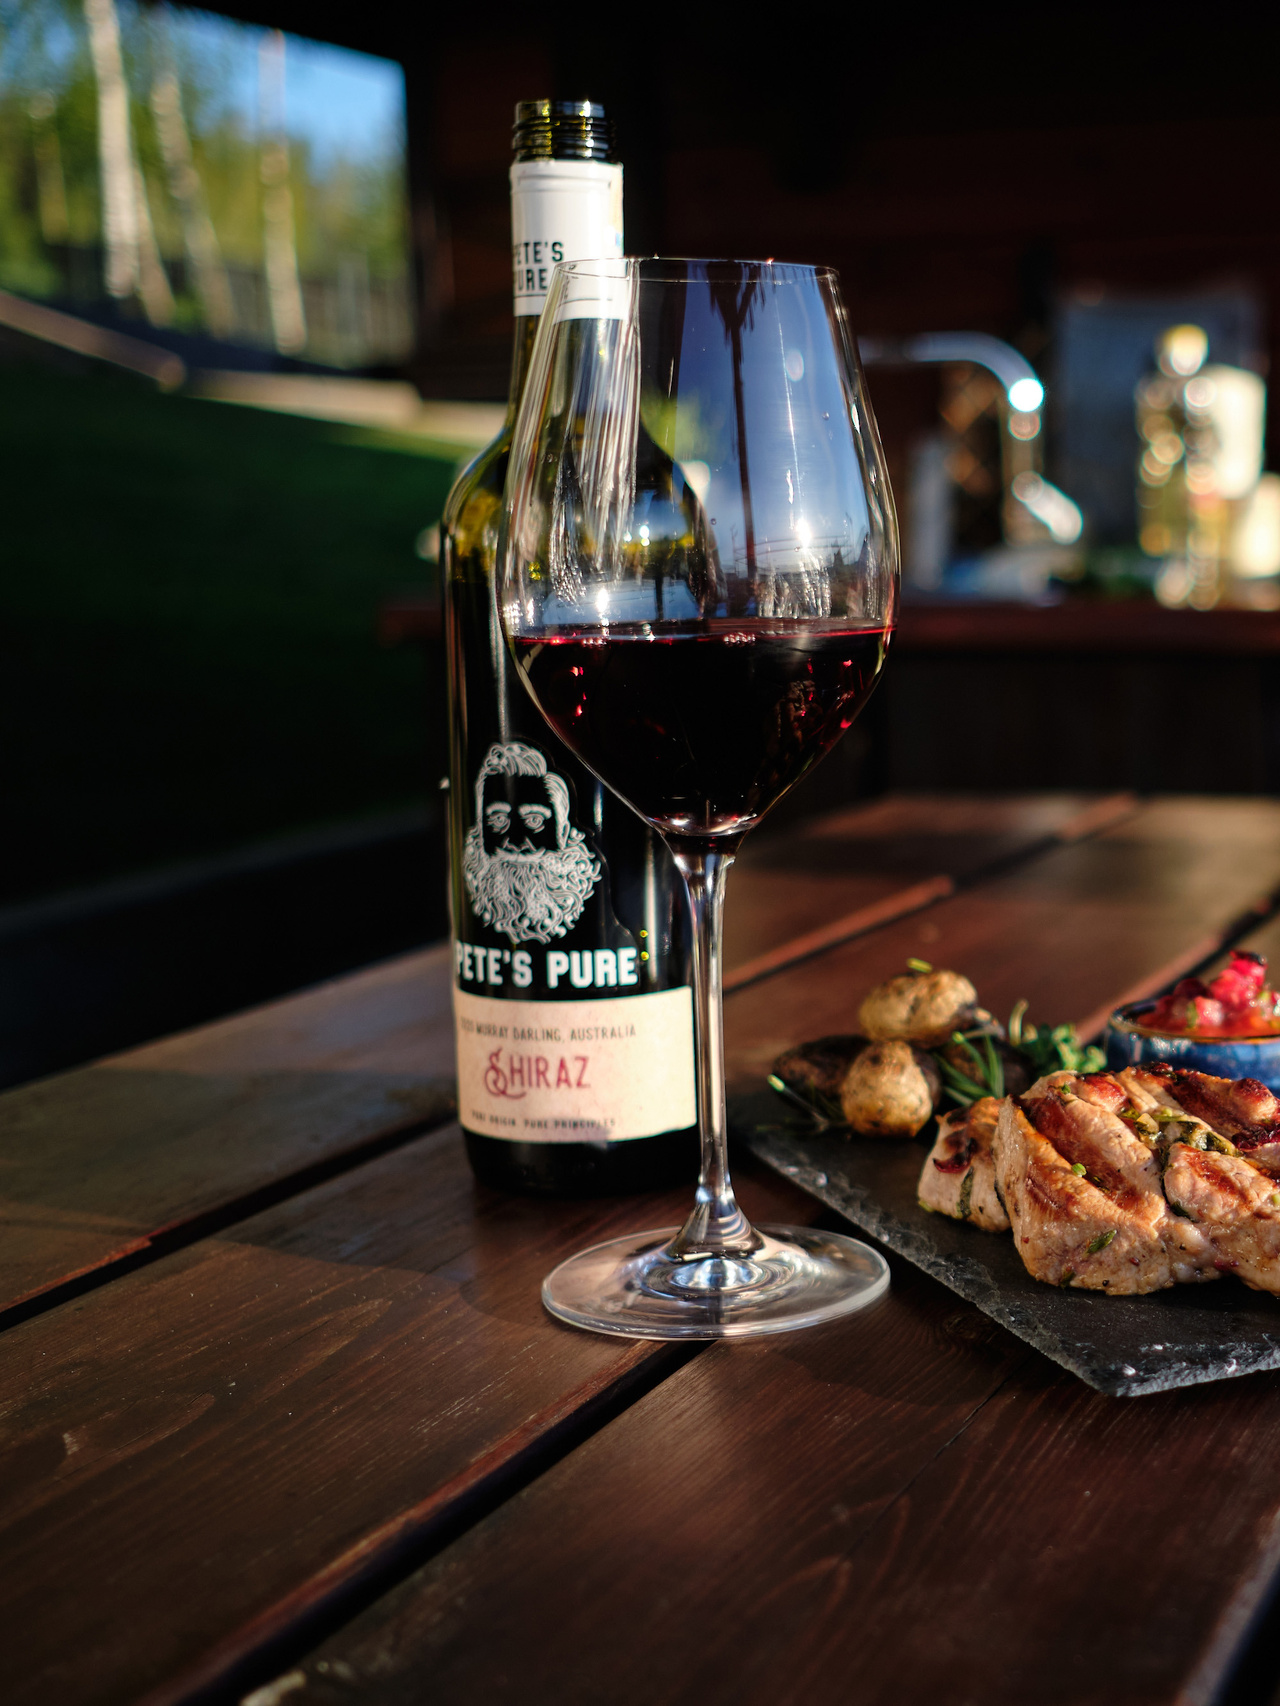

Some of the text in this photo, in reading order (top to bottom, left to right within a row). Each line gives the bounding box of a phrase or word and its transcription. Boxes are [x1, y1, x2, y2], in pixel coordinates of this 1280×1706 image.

[514, 241, 564, 265] ETE'S
[455, 939, 639, 989] PETE'S PURE
[476, 1023, 508, 1039] MURRAY
[512, 1026, 565, 1043] DARLING,
[570, 1024, 636, 1041] AUSTRALIA
[484, 1047, 592, 1099] SHIRAZ
